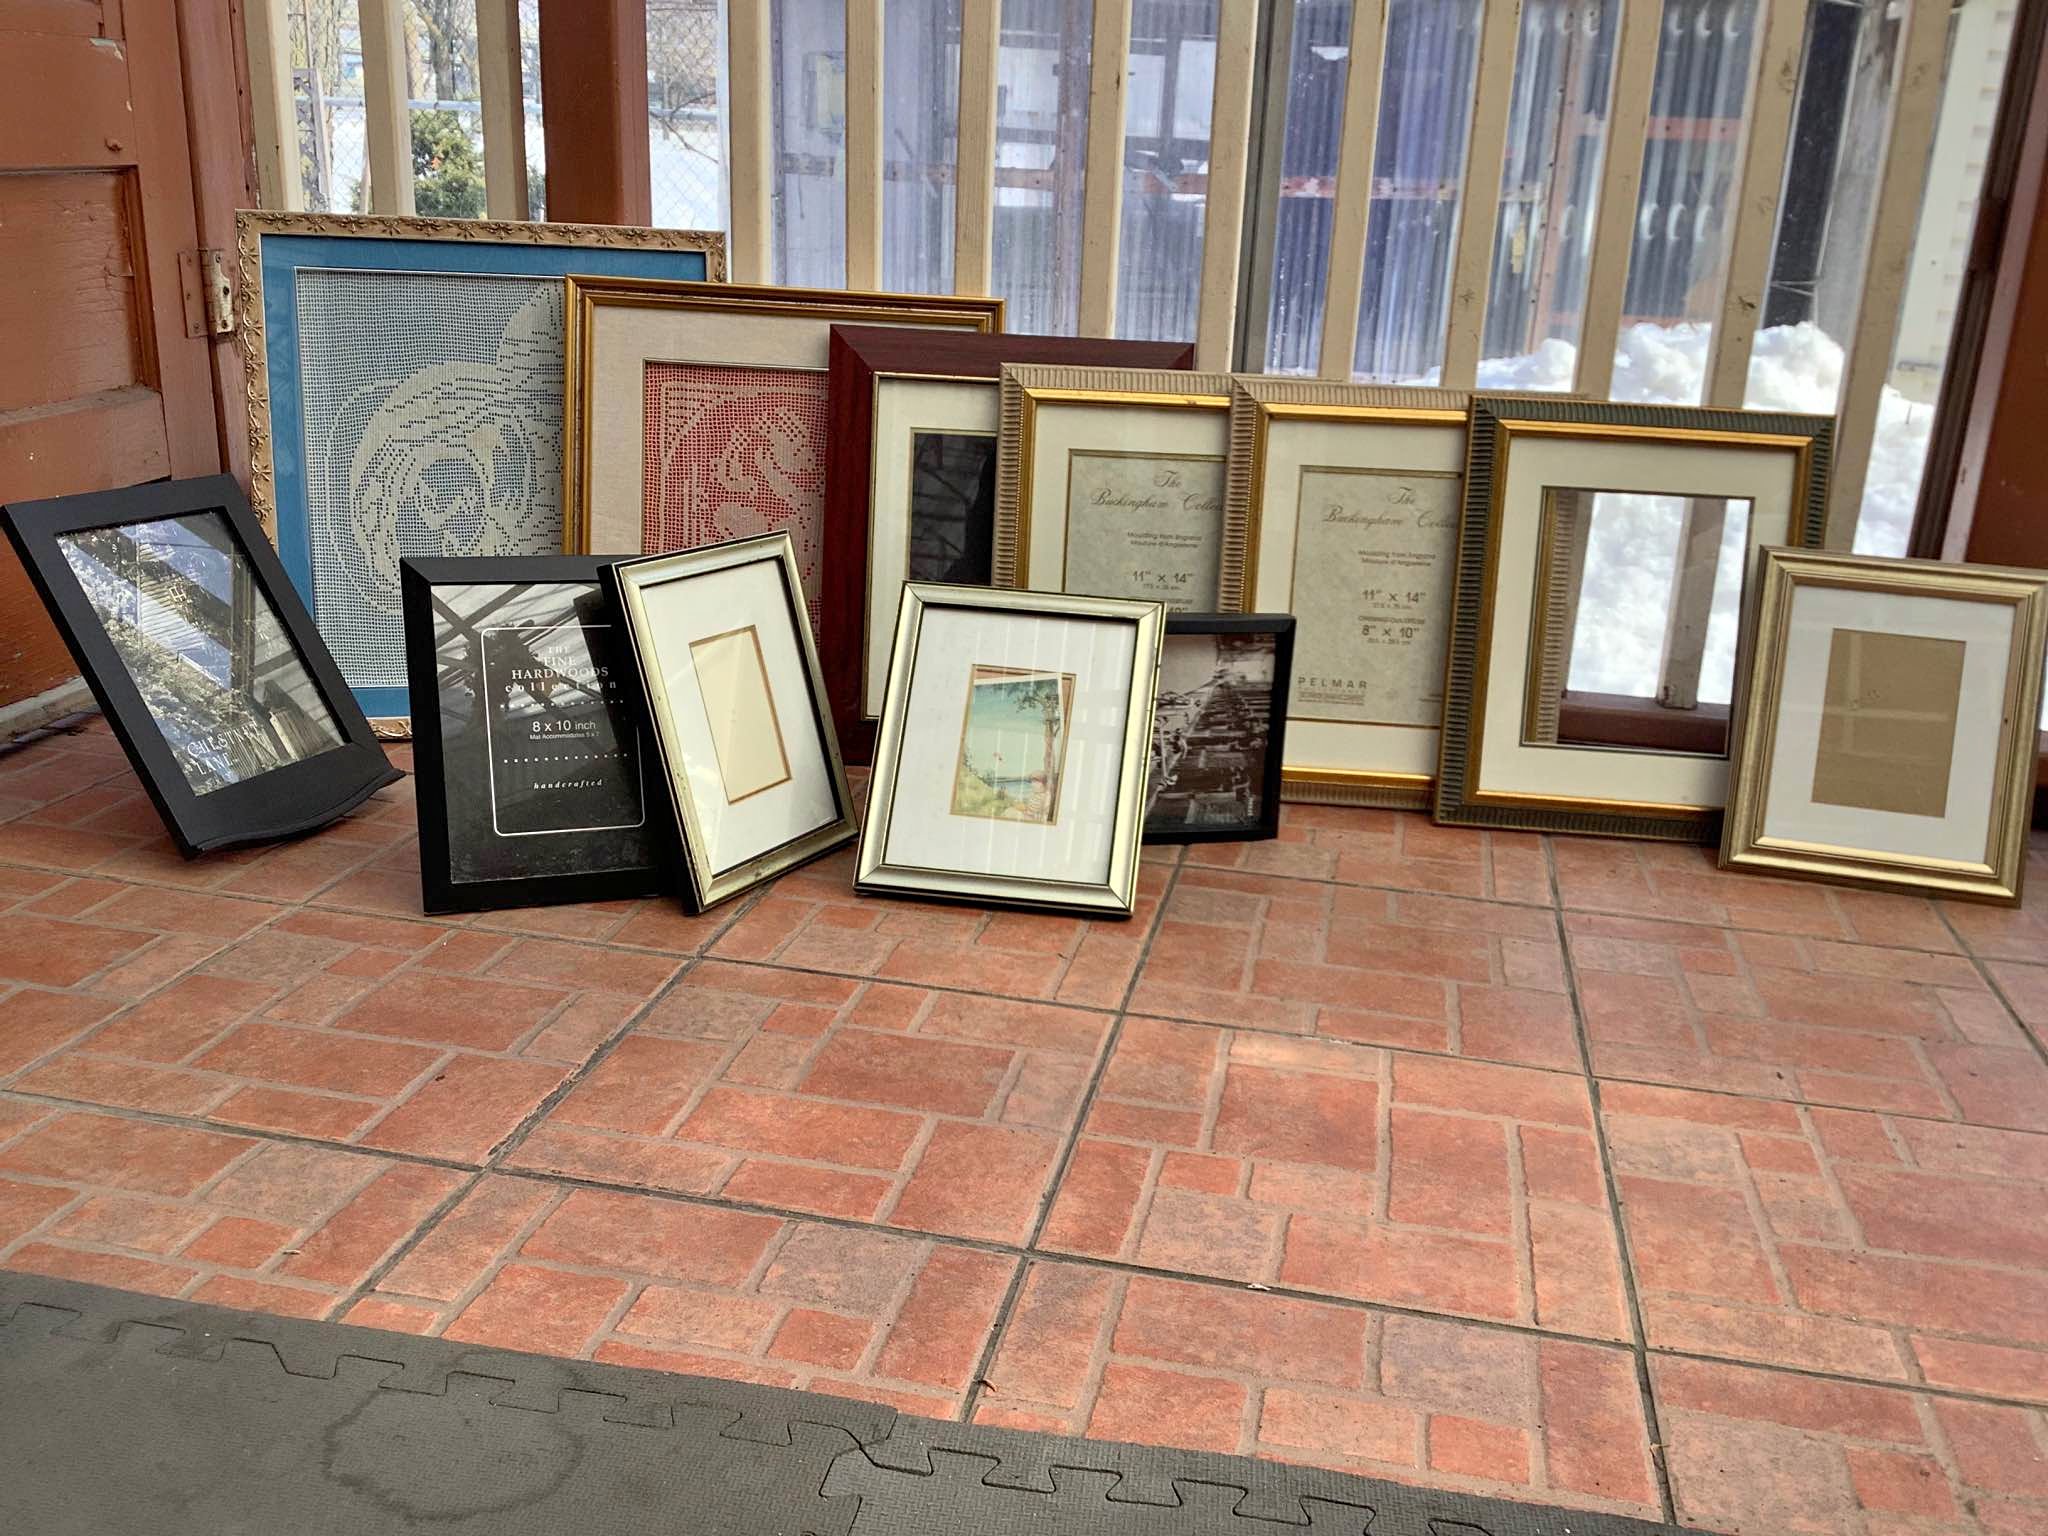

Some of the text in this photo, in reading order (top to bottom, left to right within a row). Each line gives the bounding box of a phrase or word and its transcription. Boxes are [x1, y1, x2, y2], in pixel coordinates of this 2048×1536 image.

[1153, 470, 1182, 488] The
[1090, 487, 1169, 512] Buckingham
[543, 656, 577, 667] FINE
[511, 666, 609, 680] HARDWOODS
[1297, 676, 1369, 690] PELMAR
[532, 719, 596, 732] 8 x 10 inch
[533, 778, 603, 790] handcrafted
